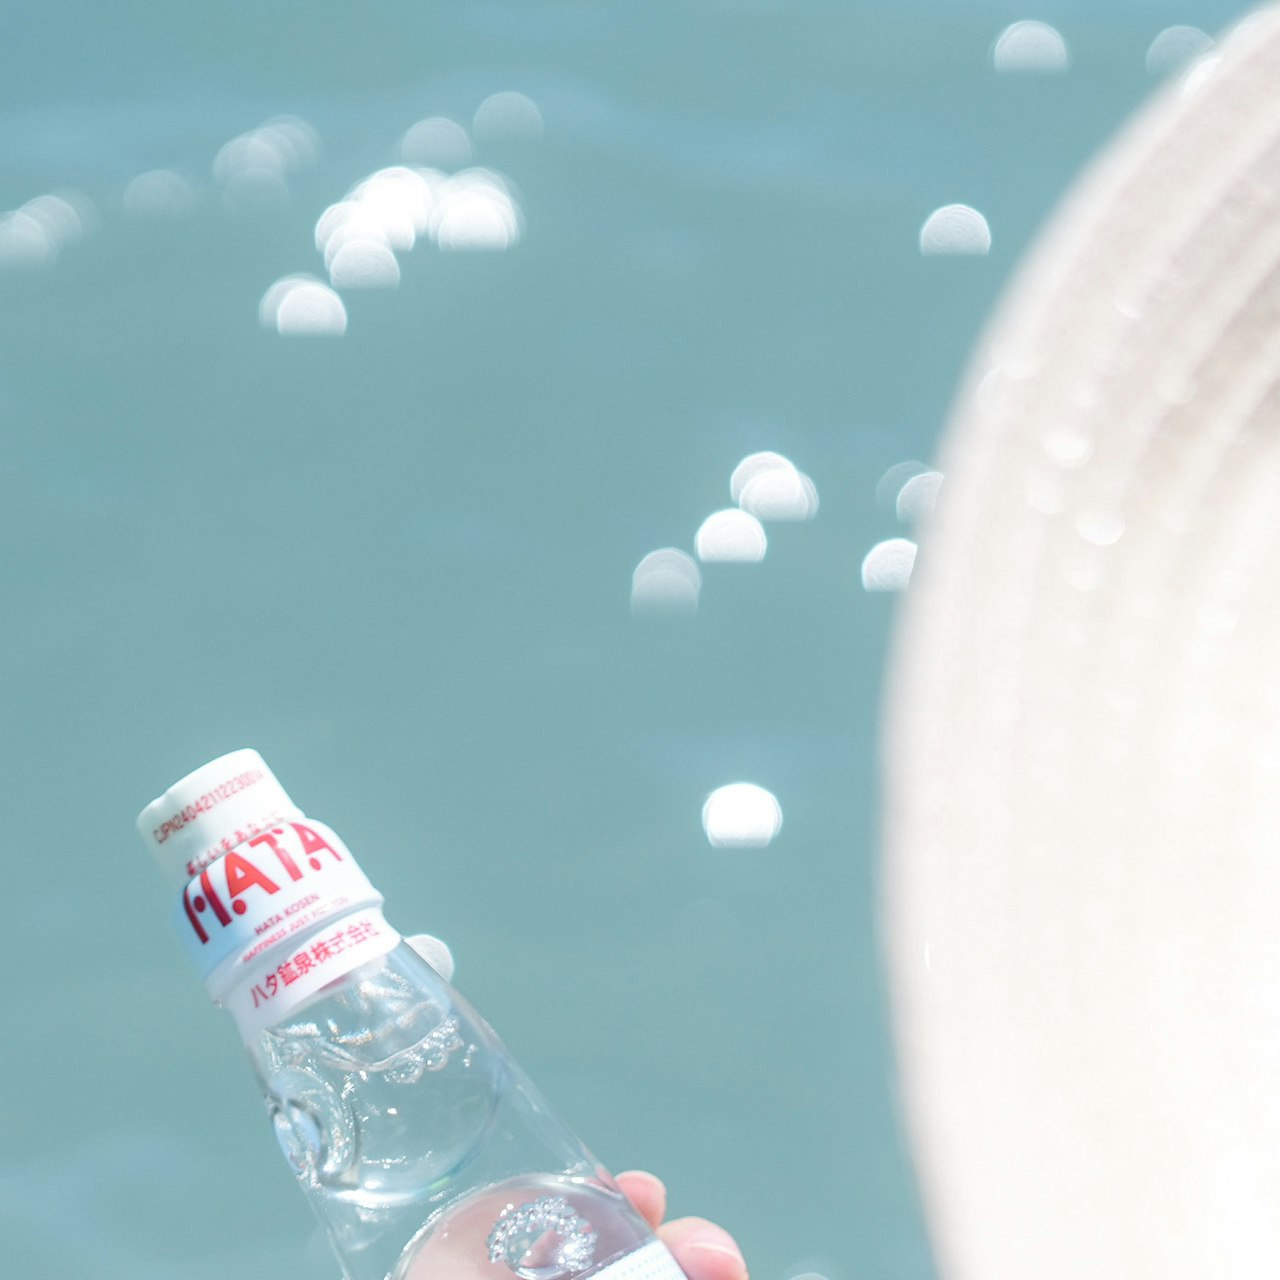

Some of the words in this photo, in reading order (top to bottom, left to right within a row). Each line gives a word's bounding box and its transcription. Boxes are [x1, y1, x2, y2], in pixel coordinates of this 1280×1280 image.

[182, 822, 343, 945] HATA
[255, 914, 283, 935] HATA
[284, 894, 319, 916] KOSEN
[290, 914, 310, 932] JUST
